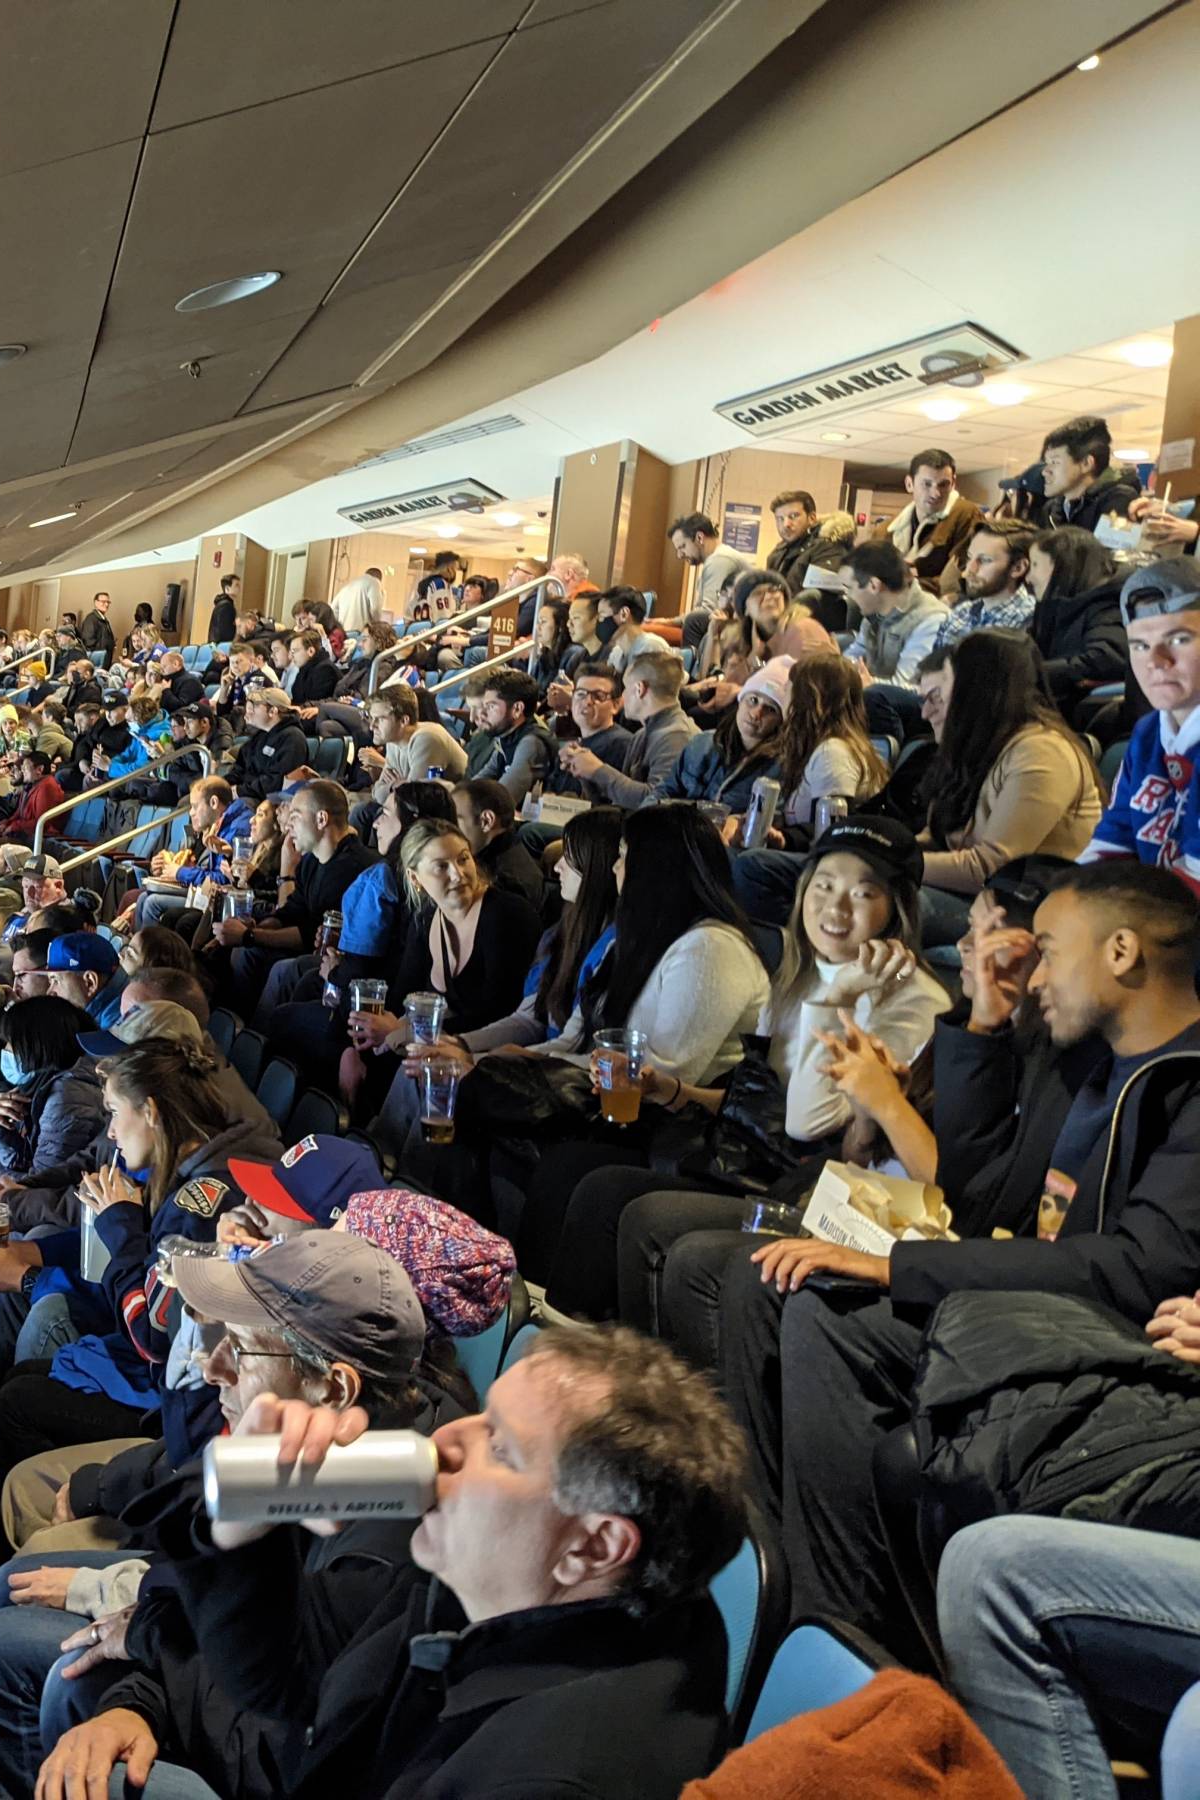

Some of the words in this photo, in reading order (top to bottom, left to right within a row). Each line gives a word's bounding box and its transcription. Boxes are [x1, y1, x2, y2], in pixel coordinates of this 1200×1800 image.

[732, 391, 823, 426] GARDEN
[815, 361, 914, 402] MARKET
[348, 506, 399, 524] GARDEN
[394, 495, 448, 515] MARKET
[493, 616, 515, 633] 416
[818, 1212, 848, 1247] MADISON
[267, 1503, 325, 1516] STELLA
[345, 1500, 405, 1513] ARTOIS
